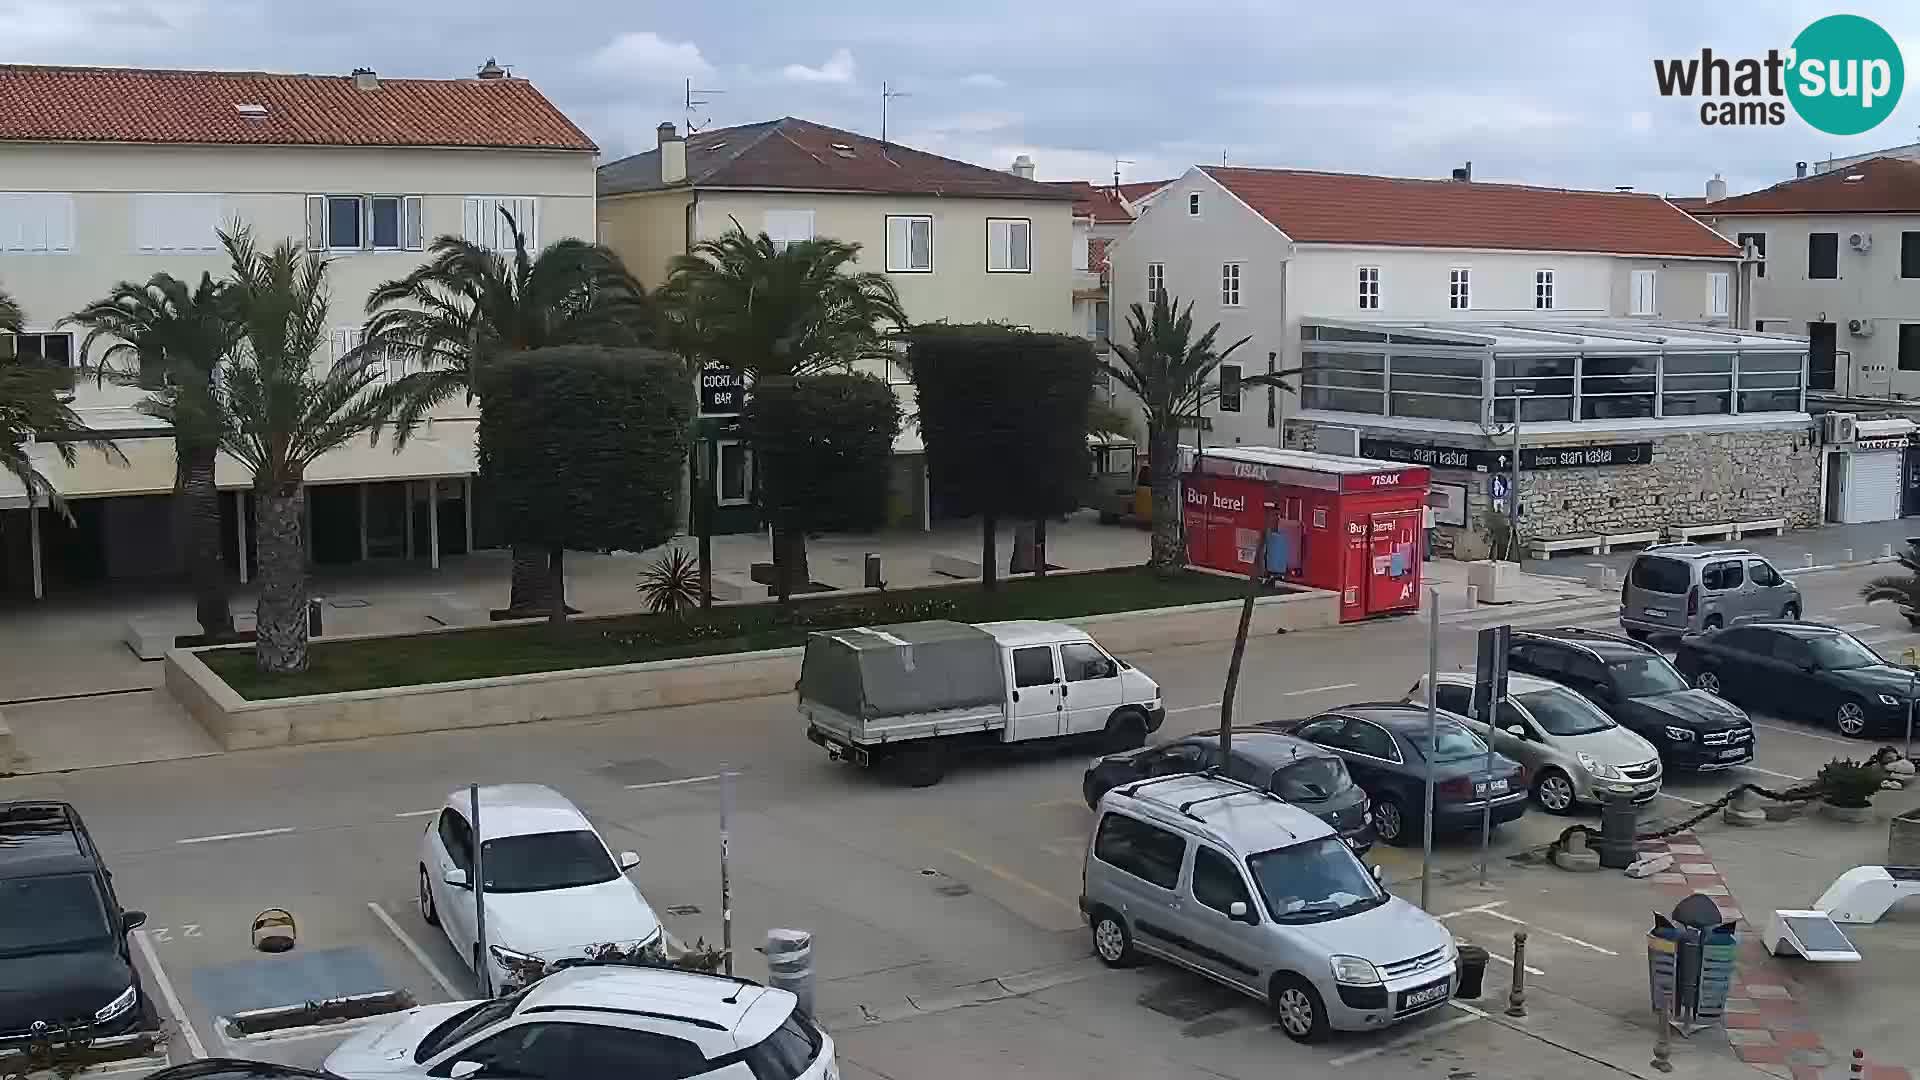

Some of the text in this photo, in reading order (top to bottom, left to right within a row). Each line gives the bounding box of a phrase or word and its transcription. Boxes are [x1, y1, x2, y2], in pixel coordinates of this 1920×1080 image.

[714, 392, 732, 405] BAR
[1371, 474, 1399, 486] TISAK
[1213, 491, 1244, 512] here!
[1349, 519, 1396, 536] Buy here!
